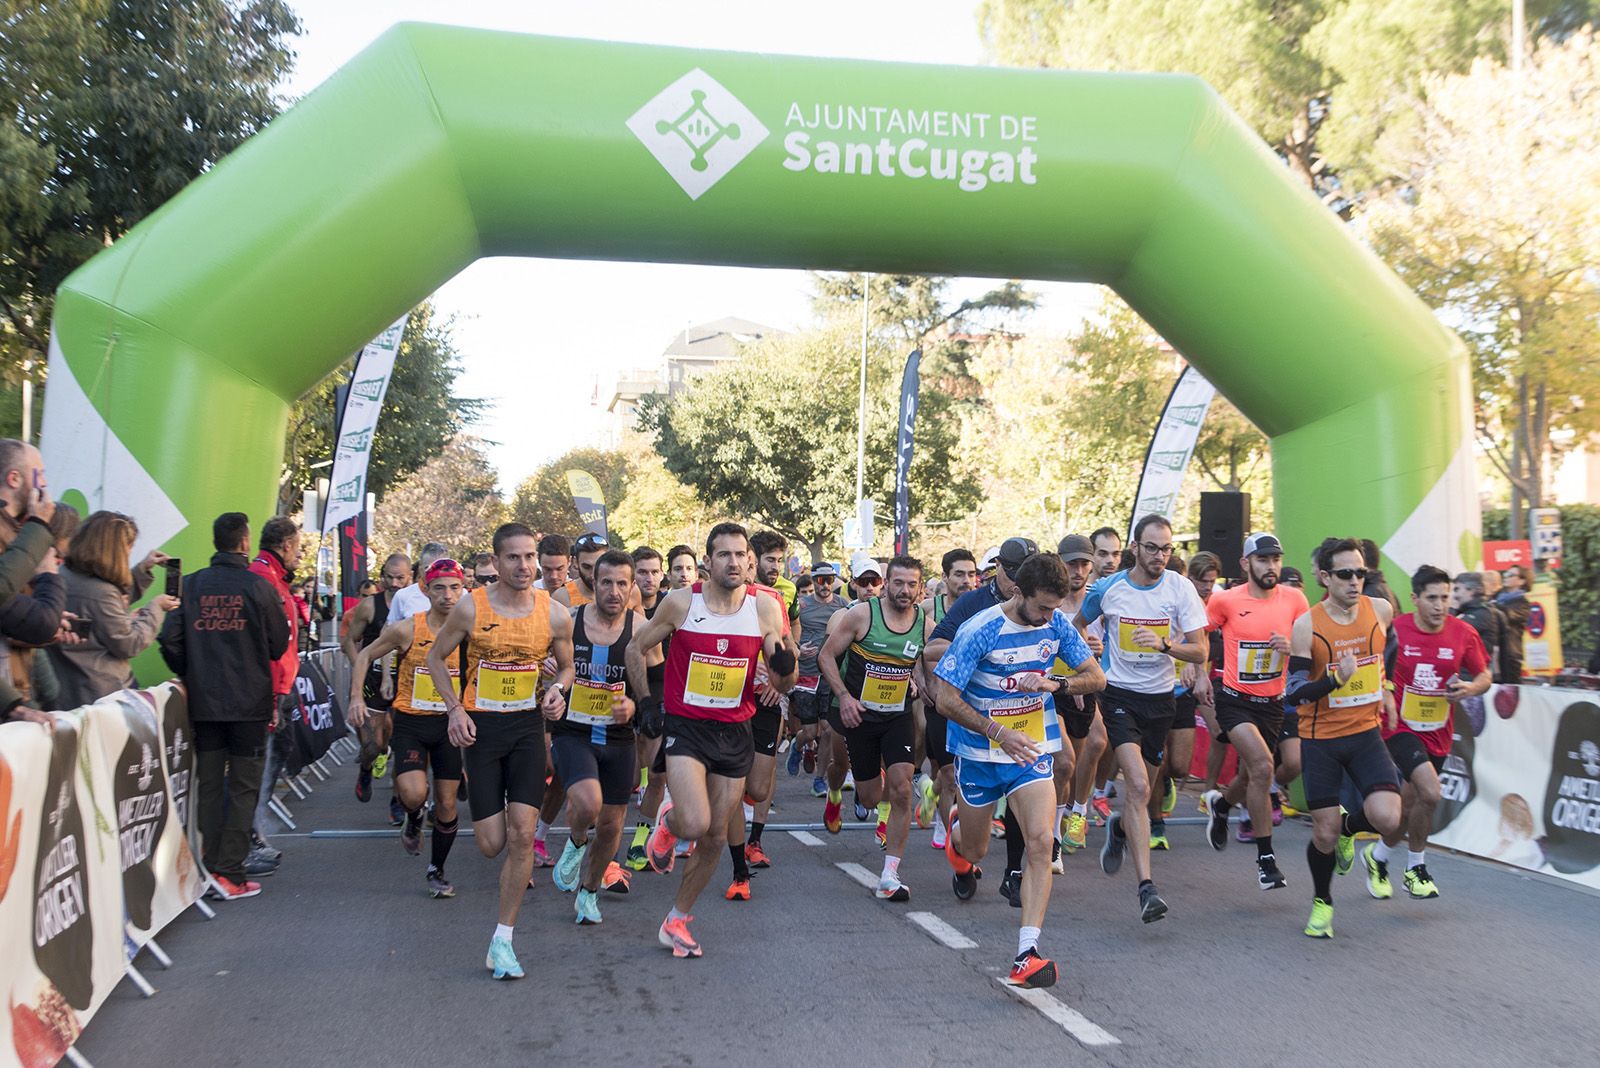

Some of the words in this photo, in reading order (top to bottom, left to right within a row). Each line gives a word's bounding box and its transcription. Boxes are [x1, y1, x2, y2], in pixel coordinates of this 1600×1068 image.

[785, 101, 991, 140] AJUNTAMENT
[1000, 115, 1038, 142] DE
[782, 131, 1039, 192] SantCugat
[1494, 548, 1522, 562] WC
[200, 595, 244, 607] MITJA
[201, 607, 242, 618] SANT
[193, 619, 248, 631] CUGAT
[574, 661, 625, 680] CONGOST
[502, 677, 515, 685] ALEX
[710, 681, 724, 692] 513
[502, 686, 515, 696] 416
[1012, 720, 1028, 730] JOSEP
[35, 870, 85, 948] ORIGEN
